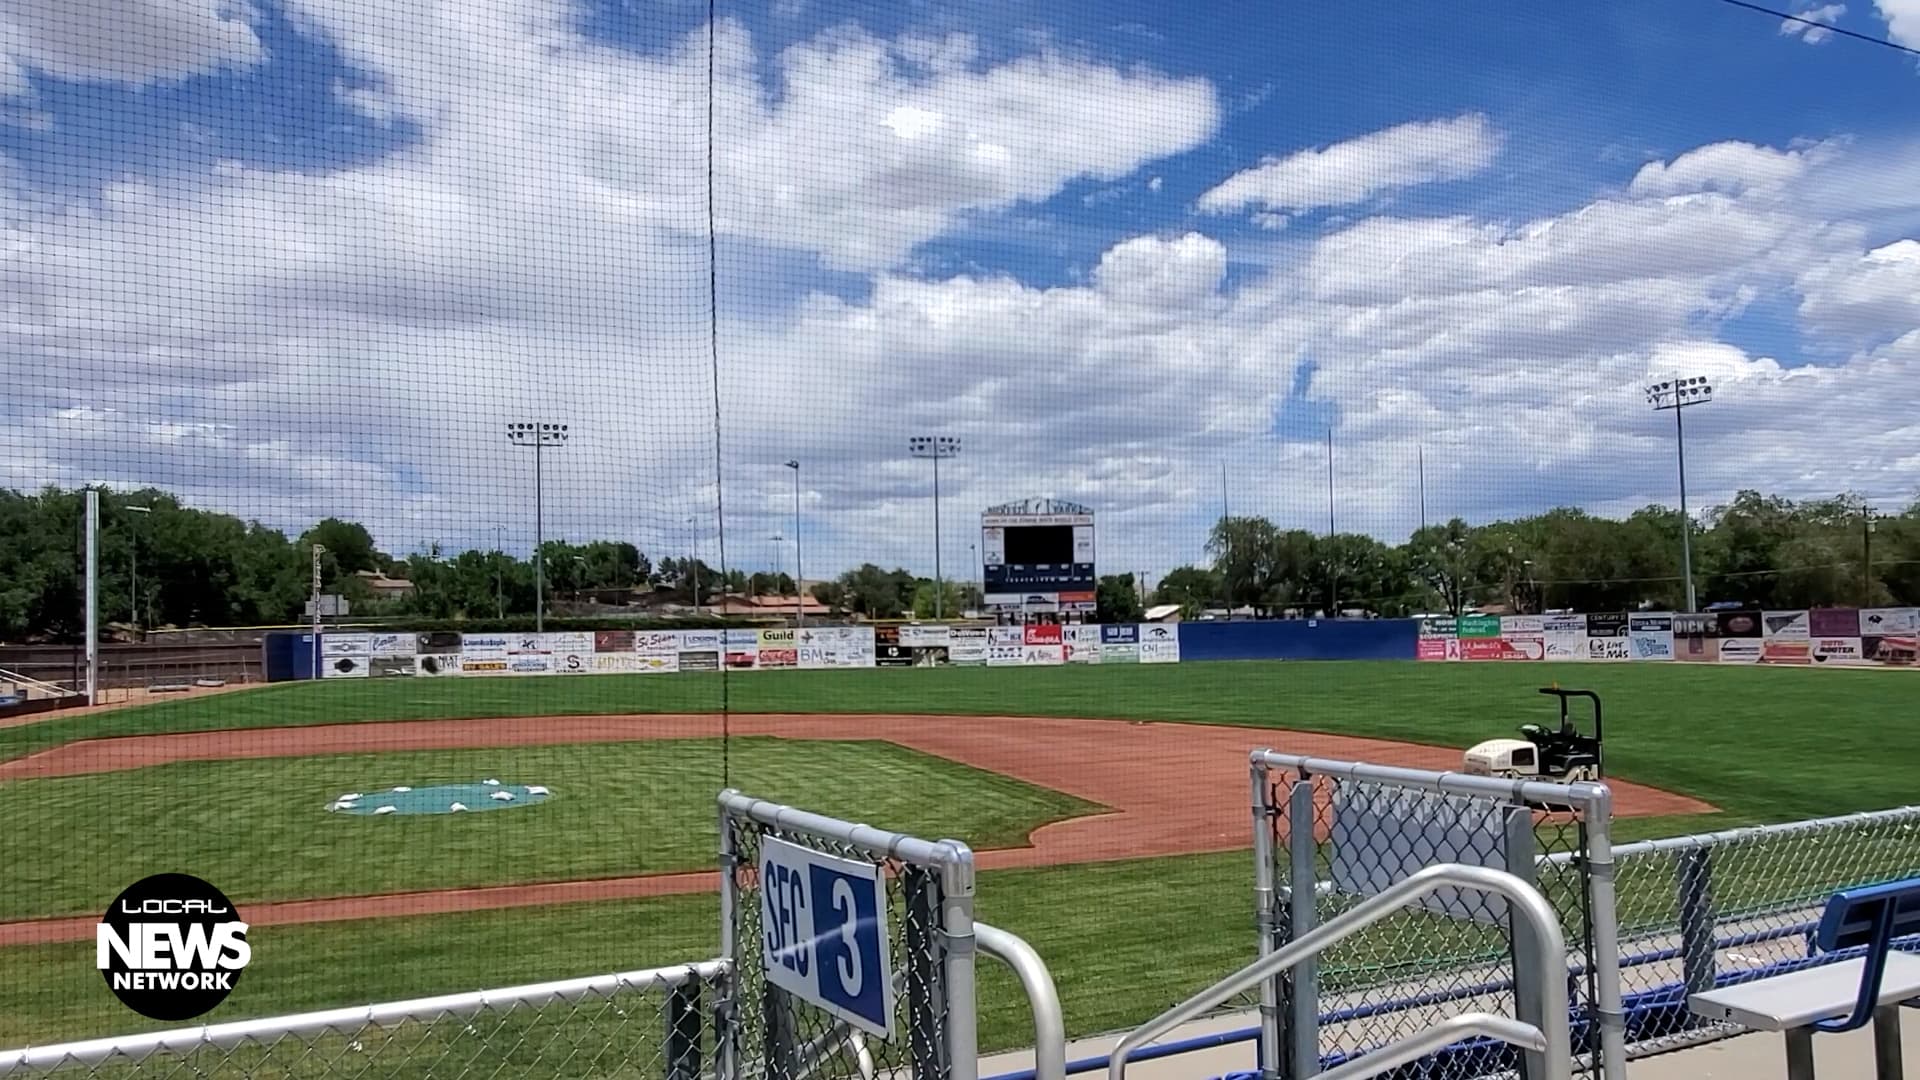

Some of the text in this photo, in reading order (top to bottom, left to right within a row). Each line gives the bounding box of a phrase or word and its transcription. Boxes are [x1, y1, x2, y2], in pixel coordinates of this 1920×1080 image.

[763, 630, 794, 640] Guild
[765, 860, 863, 998] SEC 3
[1725, 1007, 1732, 1018] F
